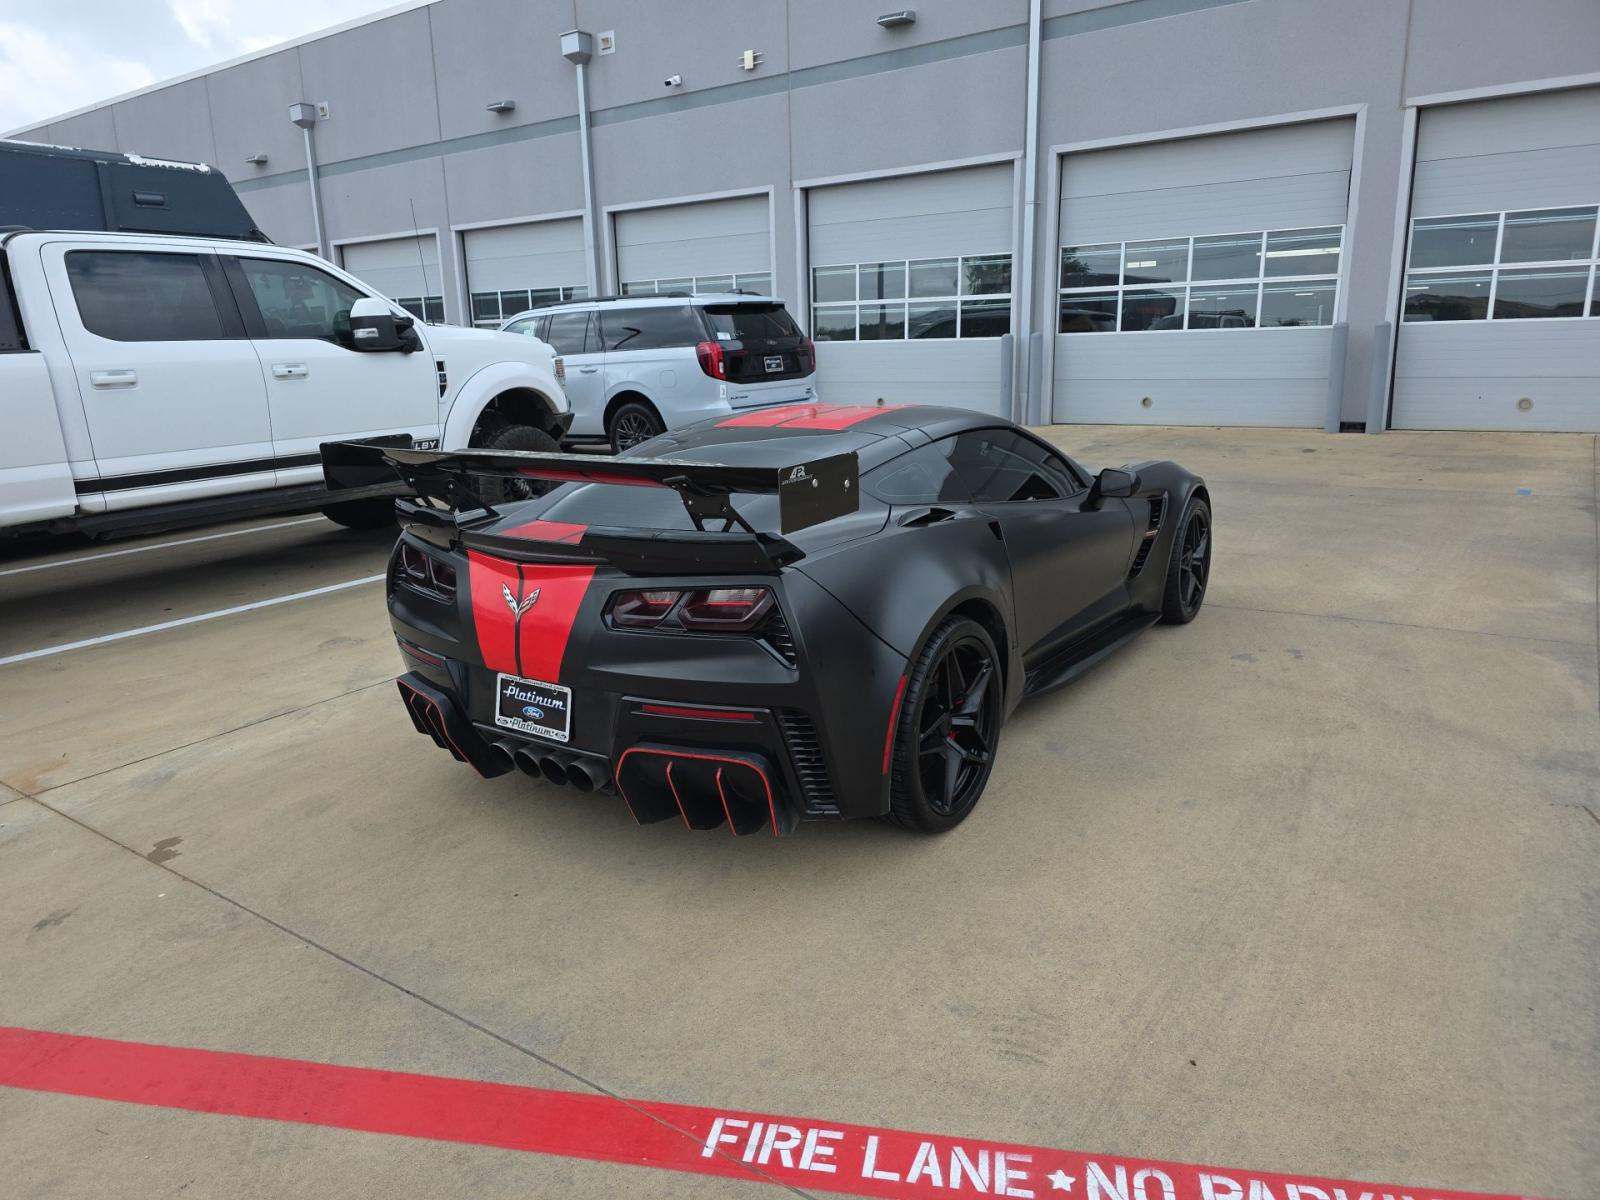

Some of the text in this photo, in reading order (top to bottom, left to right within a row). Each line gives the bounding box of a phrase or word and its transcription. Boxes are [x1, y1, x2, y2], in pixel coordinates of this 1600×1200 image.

[415, 440, 437, 450] LBY
[503, 685, 566, 711] Platinum
[511, 718, 555, 738] Platinum
[701, 1117, 844, 1174] FIRE
[861, 1135, 1036, 1199] LANE
[1086, 1161, 1176, 1200] NO
